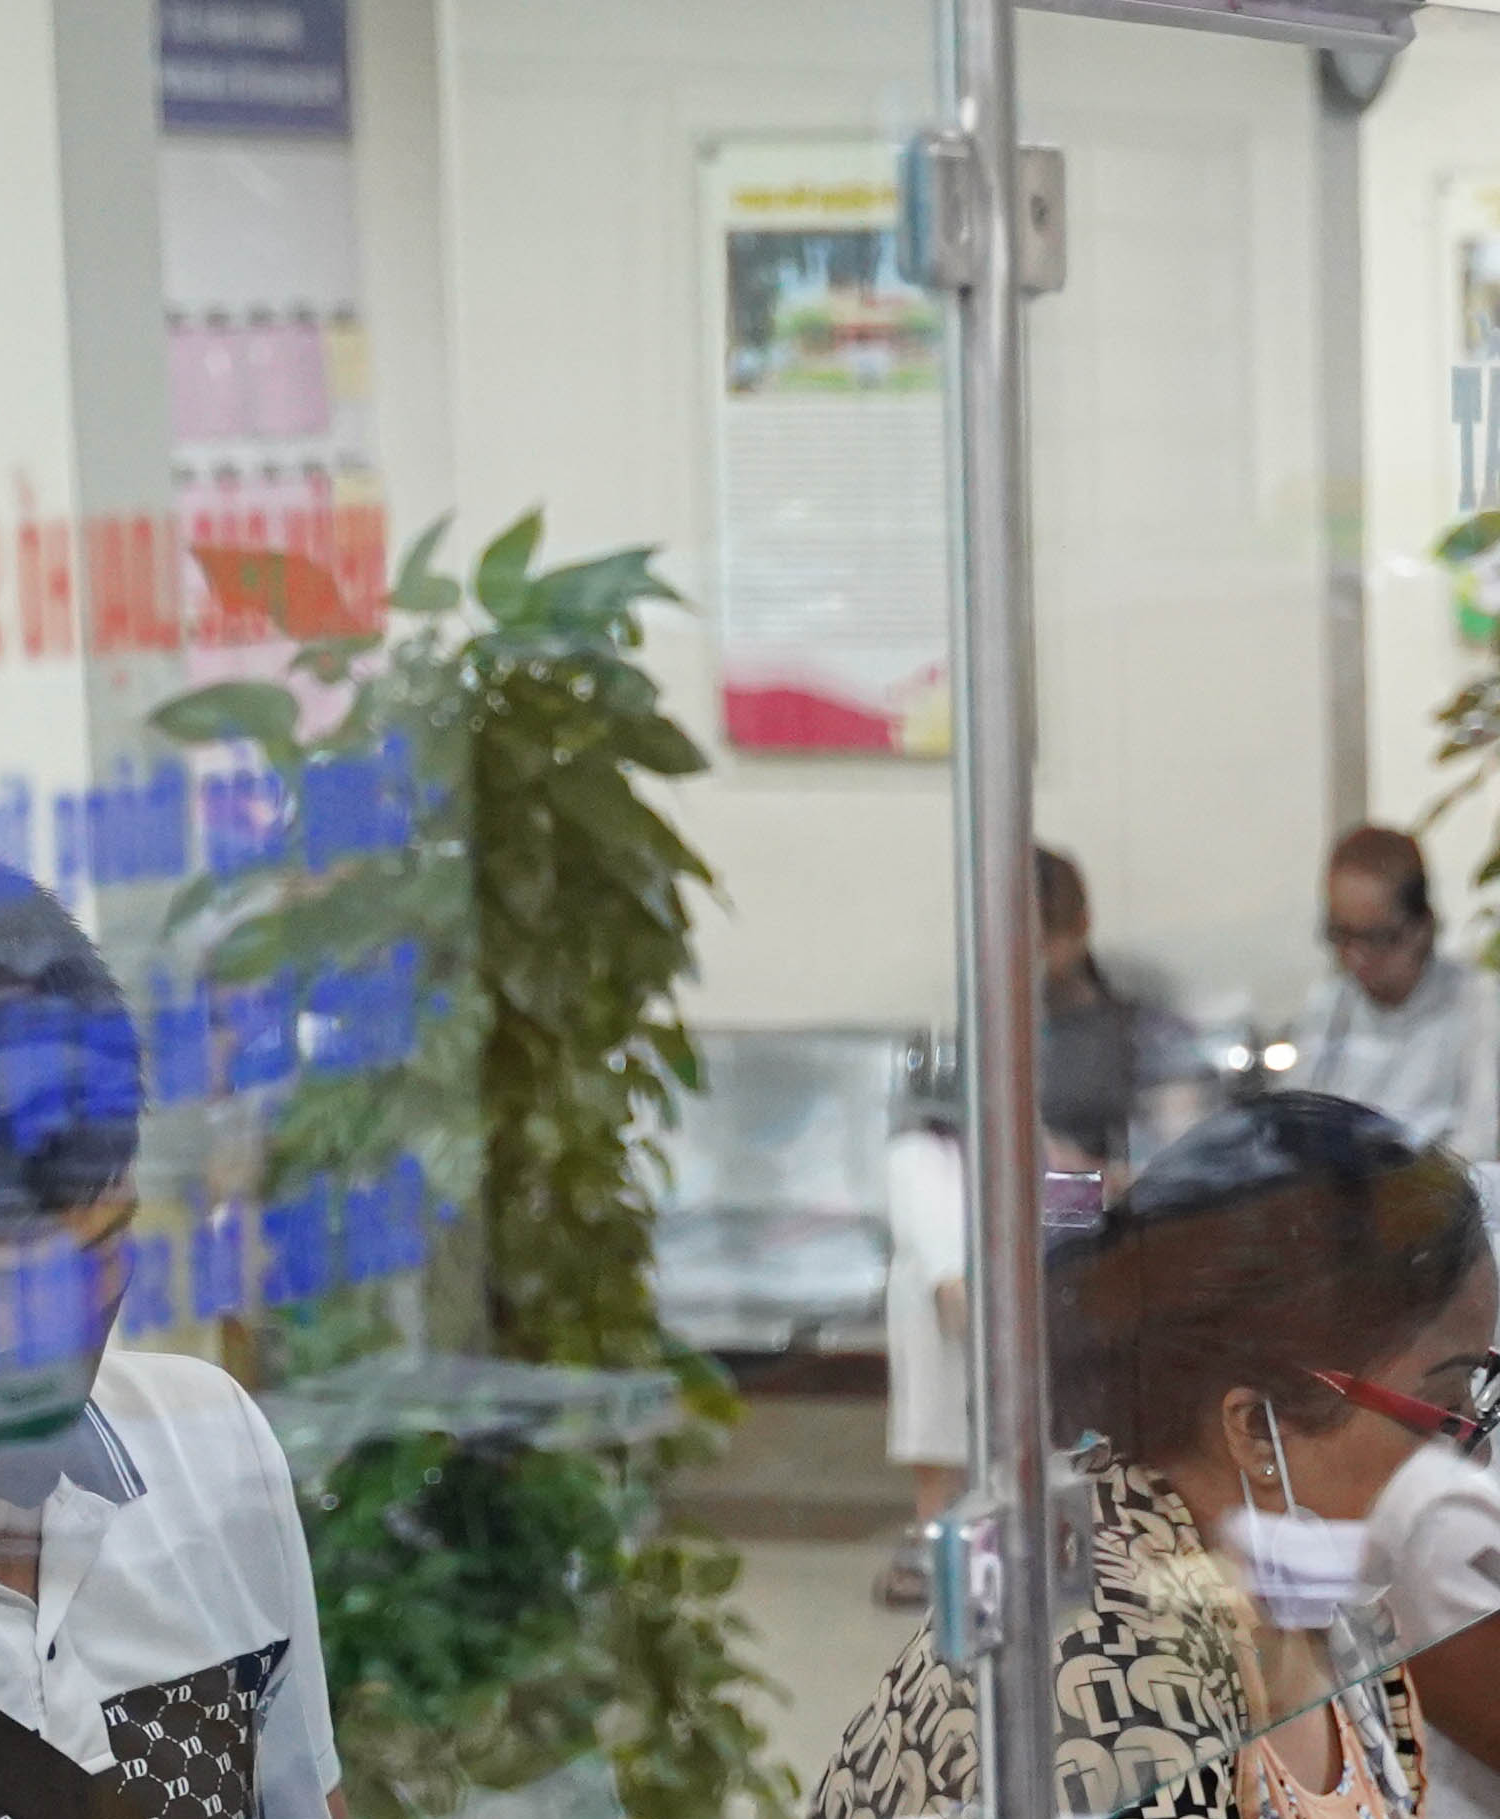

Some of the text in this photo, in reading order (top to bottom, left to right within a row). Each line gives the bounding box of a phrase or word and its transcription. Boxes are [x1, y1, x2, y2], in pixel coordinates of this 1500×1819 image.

[164, 1684, 192, 1704] YD
[105, 1704, 128, 1726] YD
[203, 1703, 229, 1720] YD
[142, 1721, 164, 1741] YD
[179, 1735, 203, 1758] YD
[121, 1758, 147, 1779] YD
[215, 1752, 231, 1774] YD
[164, 1776, 189, 1799] YD
[202, 1794, 223, 1817] YD
